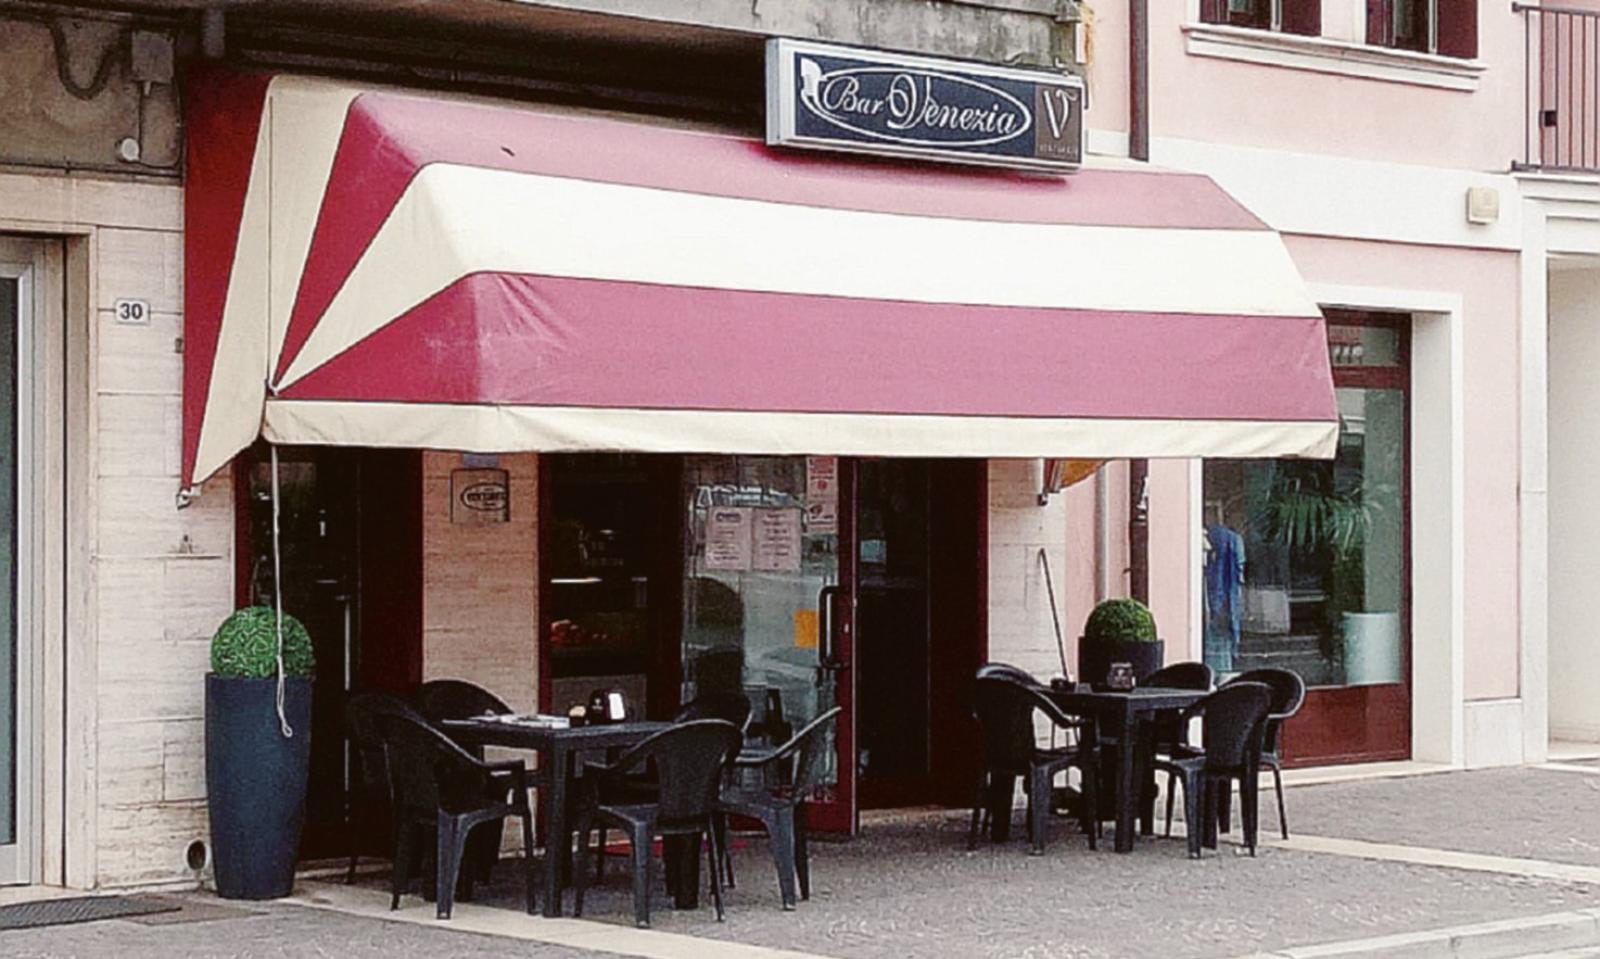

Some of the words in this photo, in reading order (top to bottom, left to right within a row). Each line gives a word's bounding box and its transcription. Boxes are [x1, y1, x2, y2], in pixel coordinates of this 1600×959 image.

[823, 76, 883, 115] Bar
[885, 74, 1018, 133] Venezia
[120, 303, 142, 319] 30
